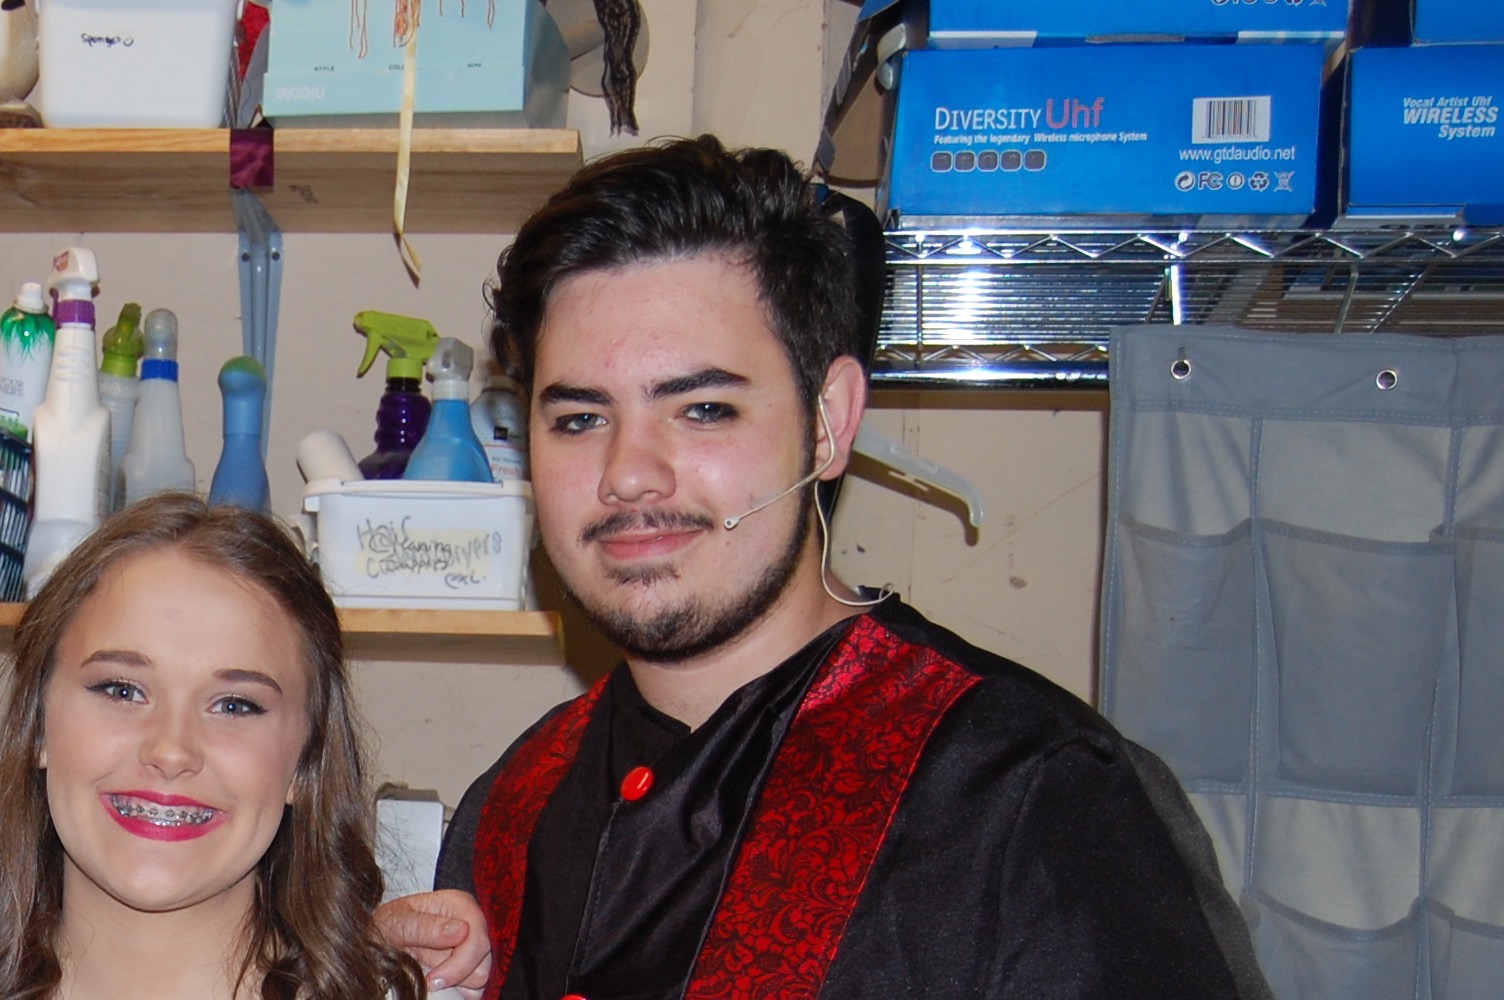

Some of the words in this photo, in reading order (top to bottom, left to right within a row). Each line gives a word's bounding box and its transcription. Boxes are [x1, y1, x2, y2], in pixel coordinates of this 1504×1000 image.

[1404, 97, 1435, 107] Vocal
[1436, 96, 1469, 107] Artist
[935, 107, 1042, 130] DIVERSITY
[1046, 97, 1105, 129] Uhf
[1403, 106, 1499, 124] WIRELESS
[934, 134, 972, 145] Featuring
[974, 133, 987, 143] the
[990, 133, 1030, 145] legendary
[1034, 132, 1067, 143] Wireless
[1068, 132, 1117, 144] microphone
[1119, 131, 1148, 143] System
[1438, 124, 1496, 140] System
[1179, 146, 1296, 164] www.gtdaudio.net
